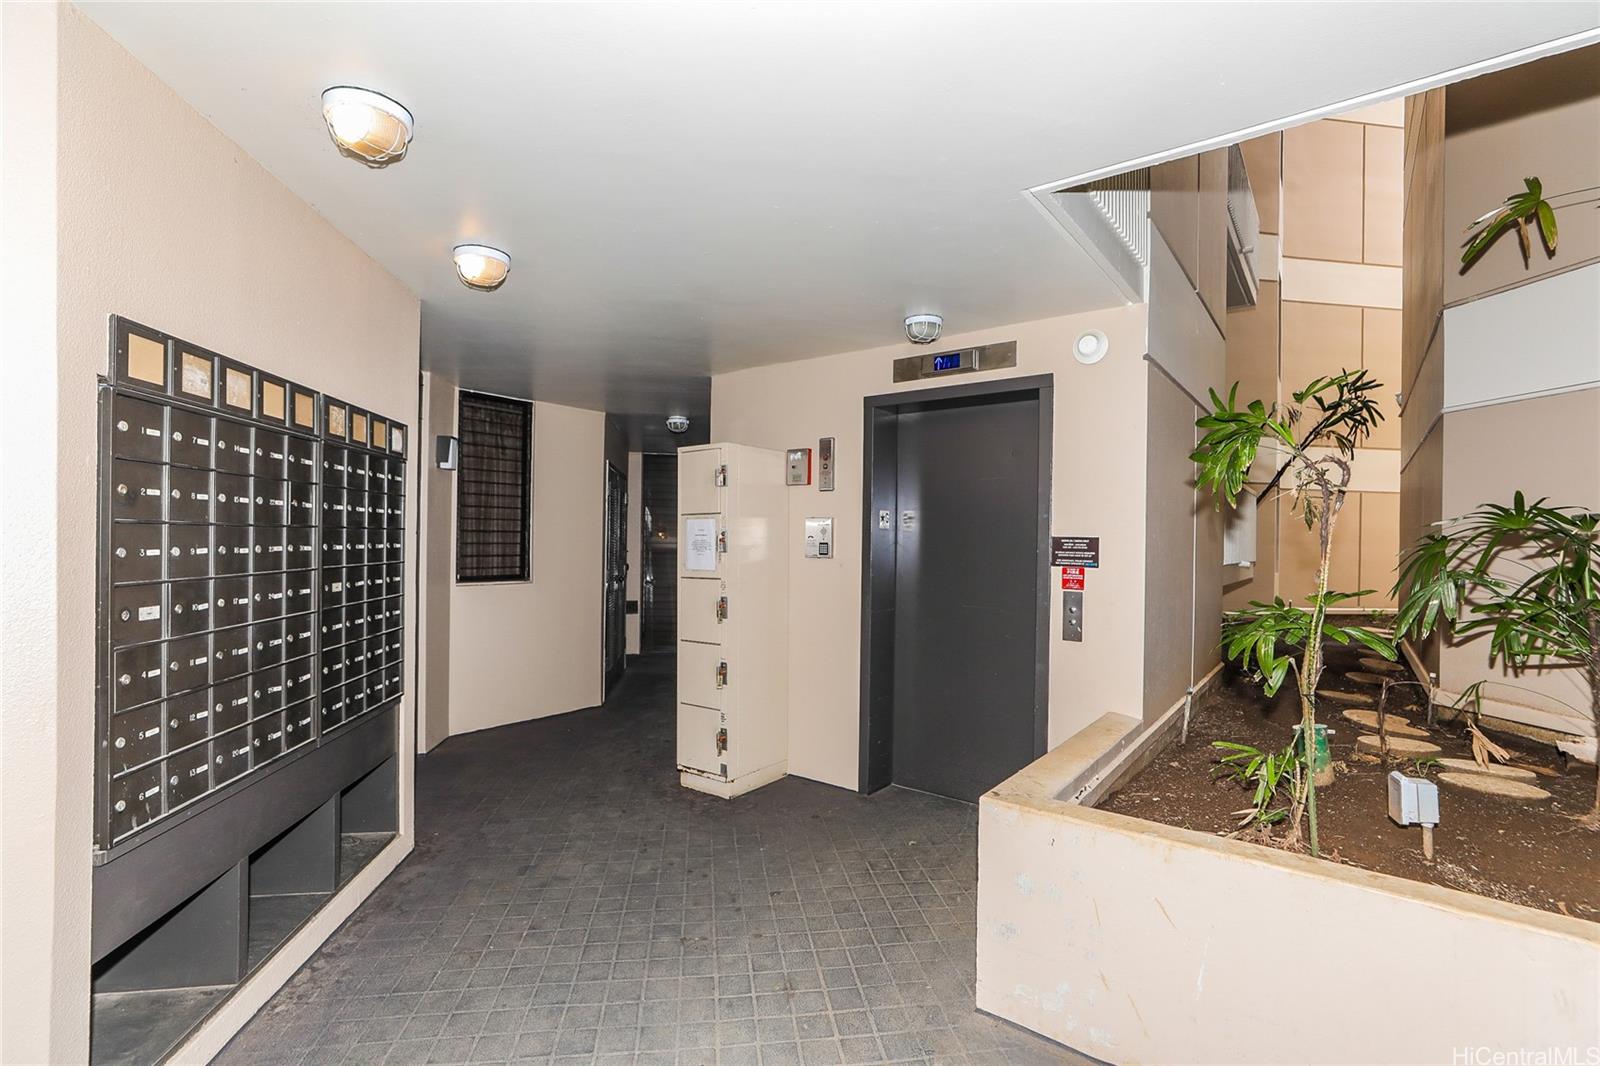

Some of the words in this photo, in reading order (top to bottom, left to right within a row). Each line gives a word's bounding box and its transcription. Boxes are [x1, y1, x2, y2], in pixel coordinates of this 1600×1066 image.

[140, 488, 146, 496] 2
[141, 670, 147, 679] 4
[189, 713, 196, 722] 12
[139, 731, 144, 740] 5
[189, 768, 196, 776] 13
[139, 791, 144, 801] 6
